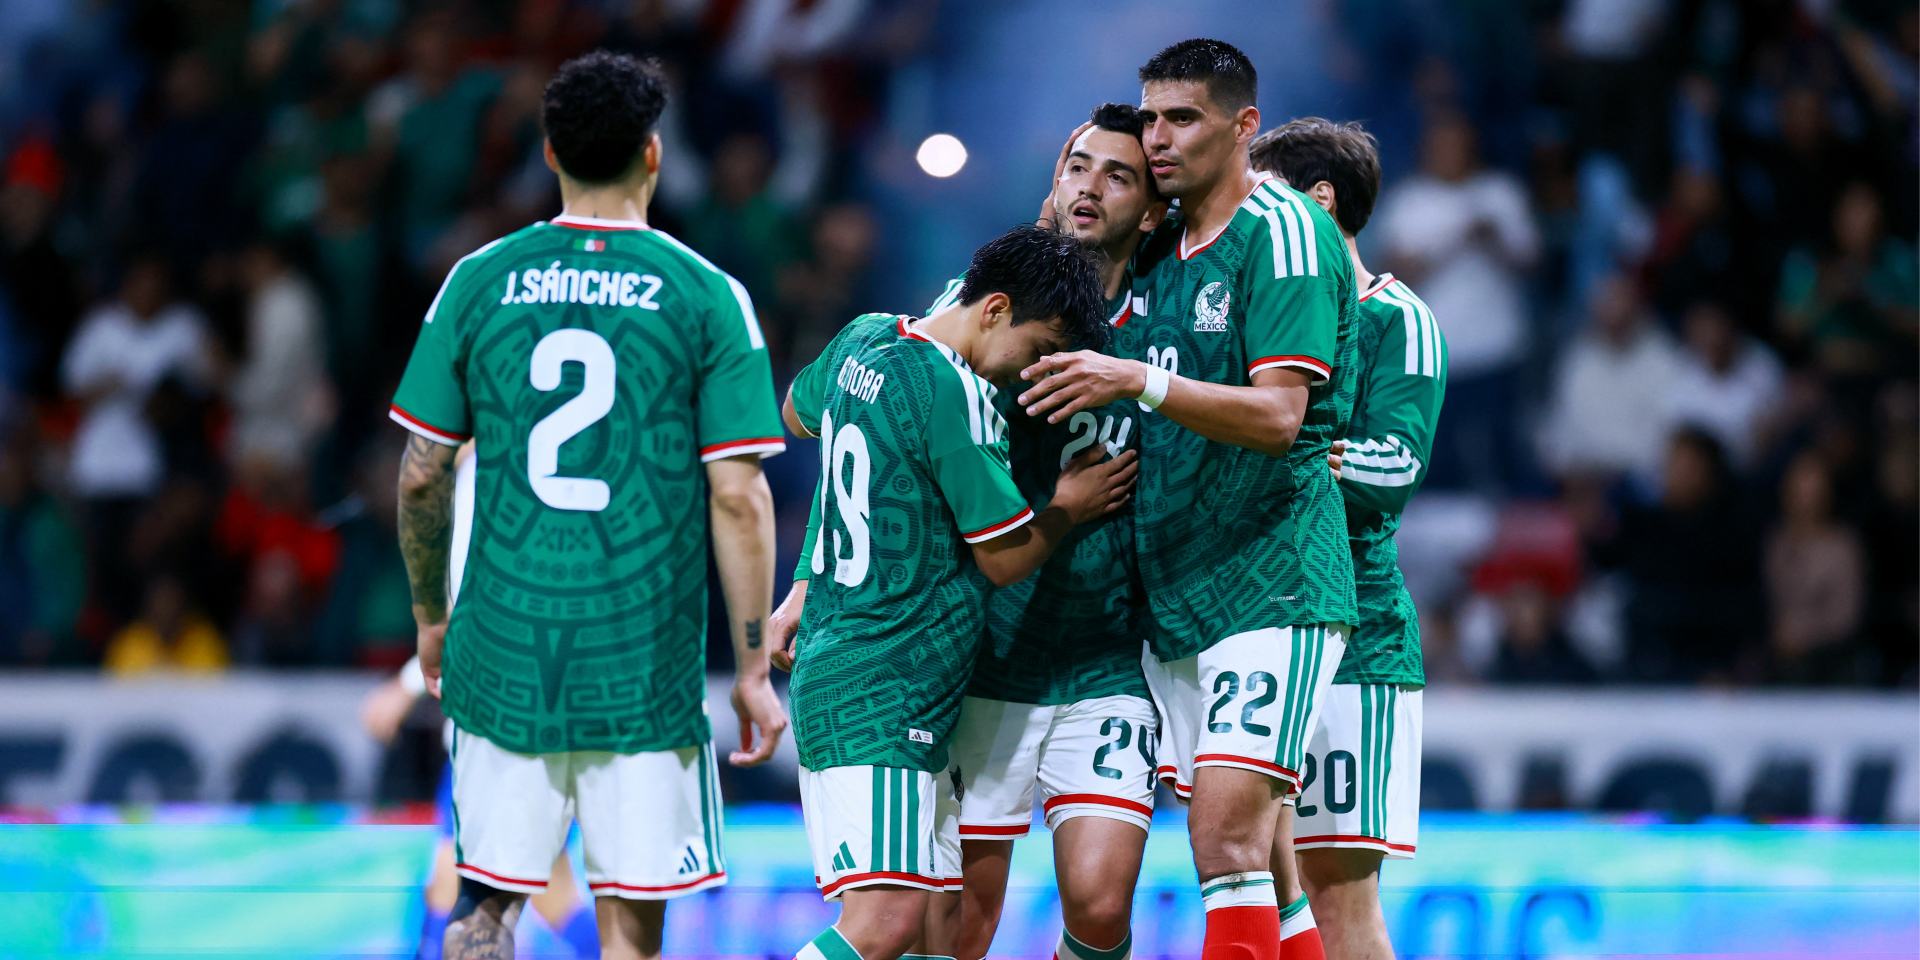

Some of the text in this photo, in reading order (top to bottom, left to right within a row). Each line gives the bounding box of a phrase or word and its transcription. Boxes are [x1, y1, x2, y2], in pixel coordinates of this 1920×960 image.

[501, 260, 663, 311] J.SÁNCHEZ
[1194, 320, 1228, 331] MÉXICO
[527, 328, 616, 511] 2
[1060, 411, 1132, 471] 24
[811, 408, 871, 588] 19
[1207, 670, 1278, 737] 22
[1092, 716, 1158, 791] 24
[1295, 750, 1357, 818] 20
